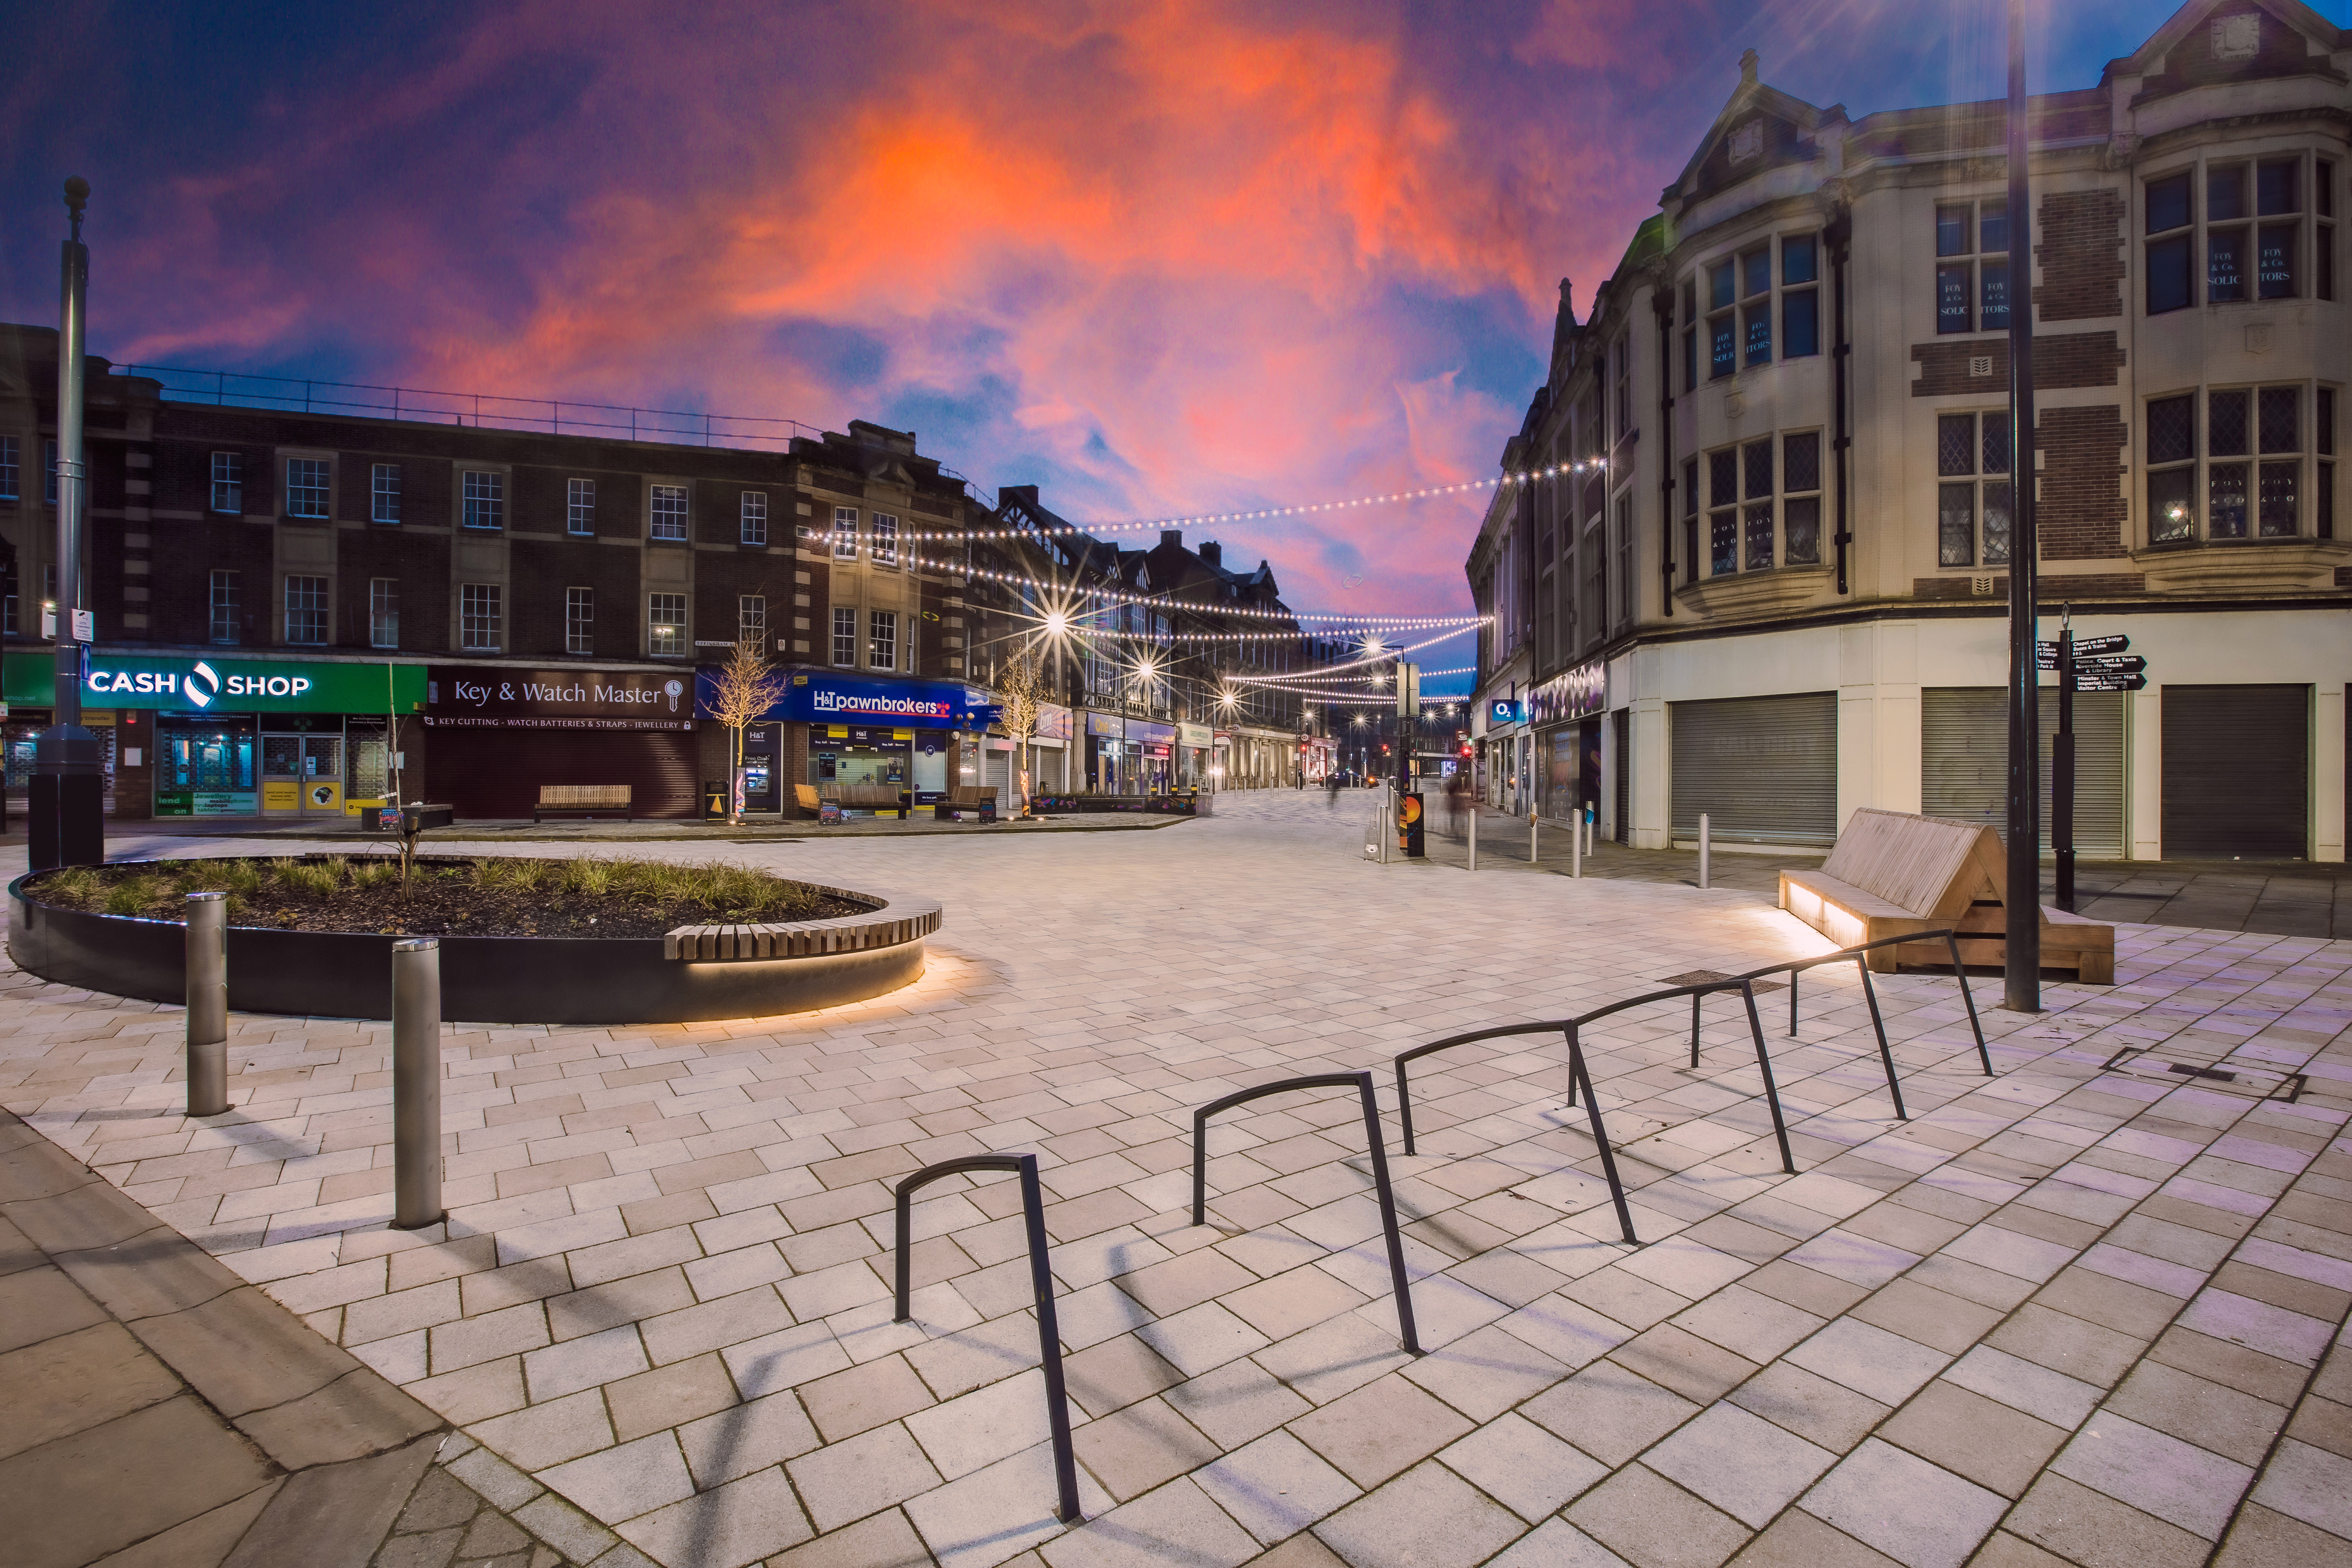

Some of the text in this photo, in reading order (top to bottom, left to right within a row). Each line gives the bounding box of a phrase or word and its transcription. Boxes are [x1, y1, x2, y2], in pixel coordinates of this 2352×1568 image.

[2214, 252, 2233, 261] FOY
[2264, 248, 2282, 257] FOY
[1945, 284, 1961, 293] FOY
[1988, 282, 2005, 291] FOY
[1717, 332, 1730, 343] FOY
[89, 671, 310, 696] CASH SHOP
[456, 682, 661, 707] Key & Watch Master
[836, 695, 937, 714] pawnbrokers
[1095, 718, 1109, 733] One
